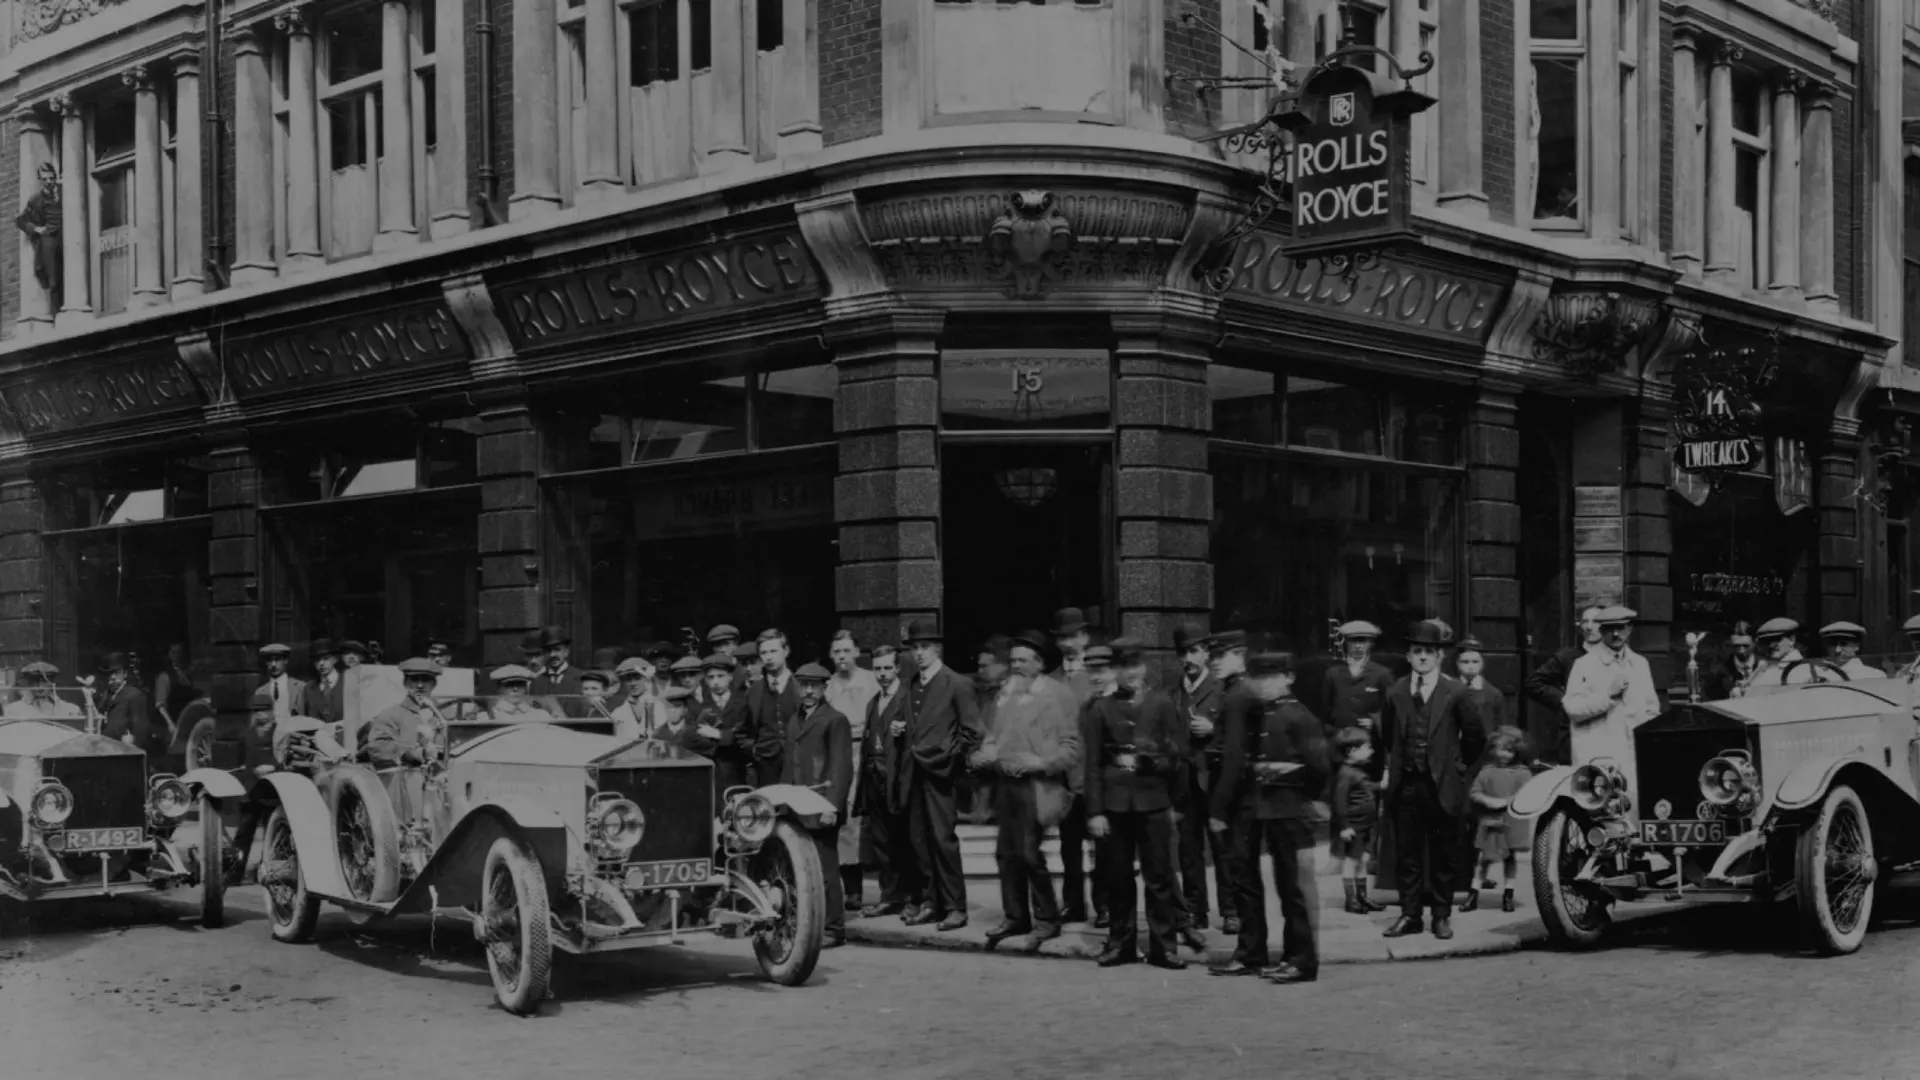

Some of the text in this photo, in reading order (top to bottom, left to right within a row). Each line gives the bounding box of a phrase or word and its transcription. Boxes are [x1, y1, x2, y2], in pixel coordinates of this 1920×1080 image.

[1298, 129, 1388, 178] ROLLS
[1298, 178, 1389, 226] ROYCE
[1012, 367, 1043, 393] 15
[68, 829, 138, 849] R-1492
[1644, 823, 1721, 841] R-1706
[628, 861, 706, 884] -1705
